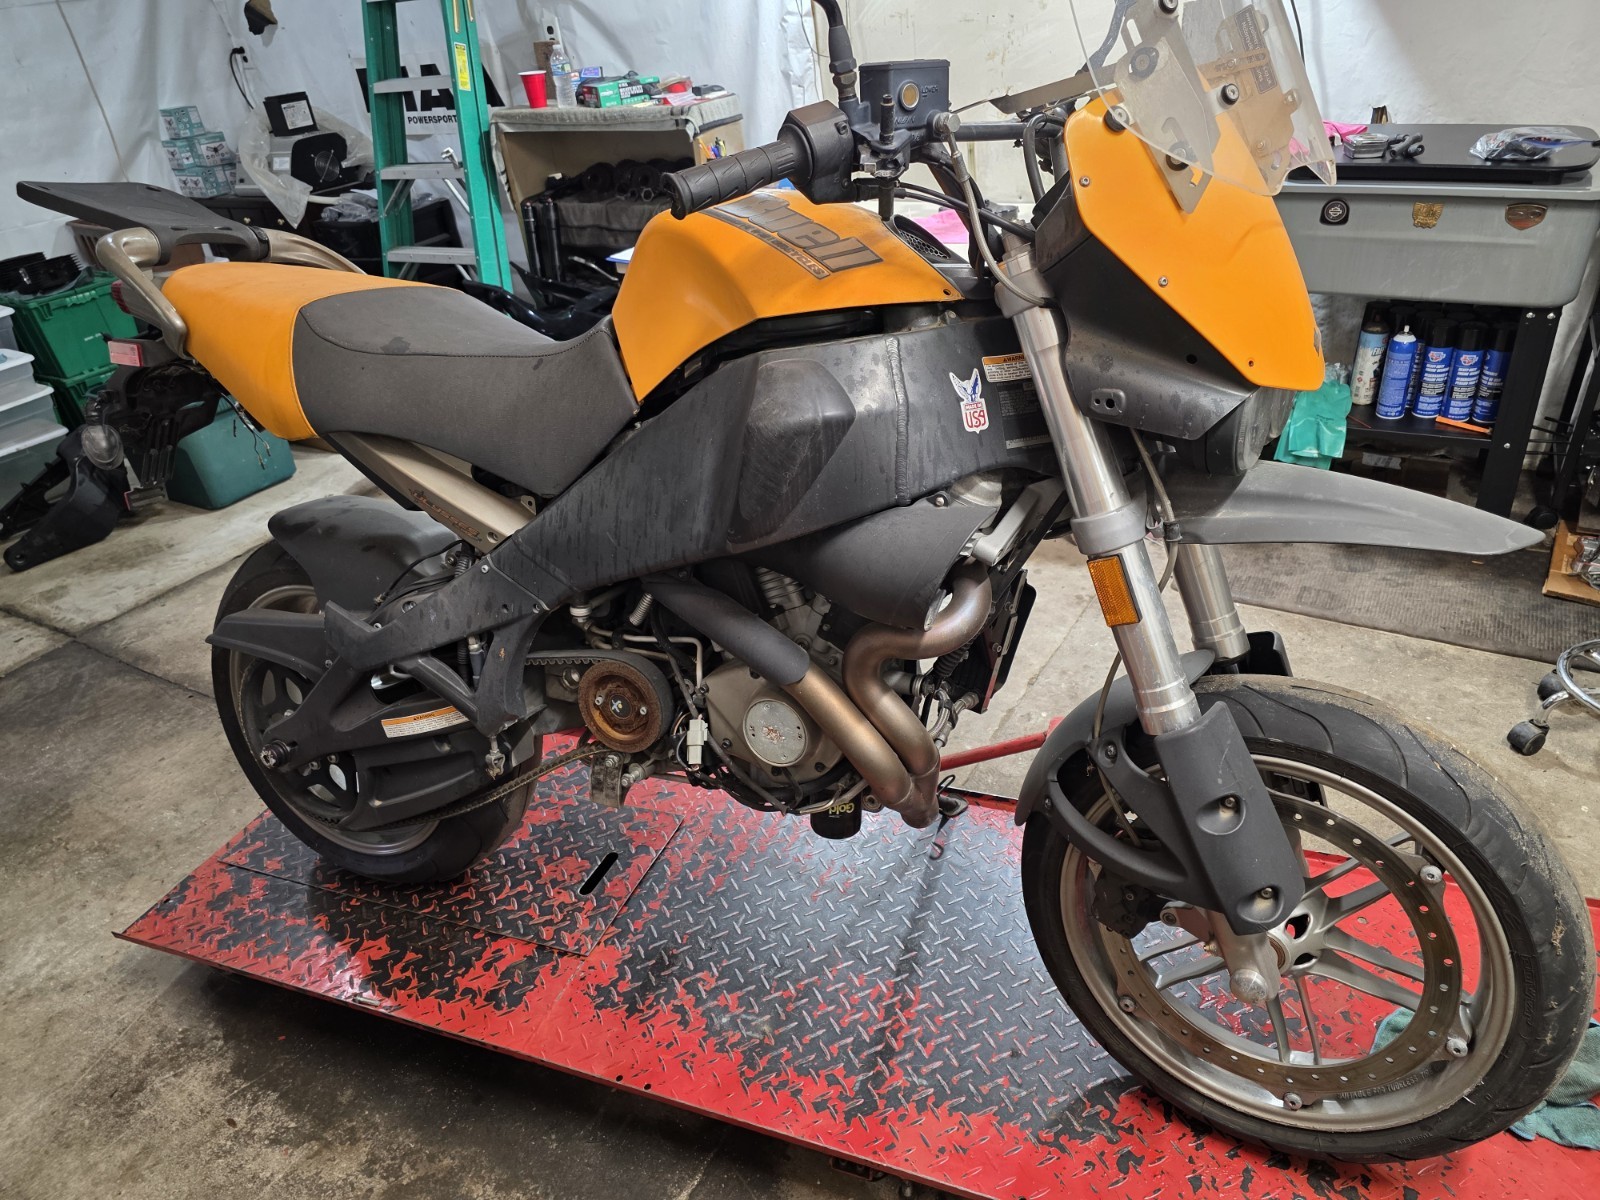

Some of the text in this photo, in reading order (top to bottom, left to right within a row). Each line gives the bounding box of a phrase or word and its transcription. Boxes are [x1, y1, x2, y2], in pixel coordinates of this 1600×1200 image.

[407, 115, 458, 124] POWERSPORT
[1005, 354, 1025, 362] WARNI
[965, 410, 986, 428] USA
[829, 802, 854, 815] Gold
